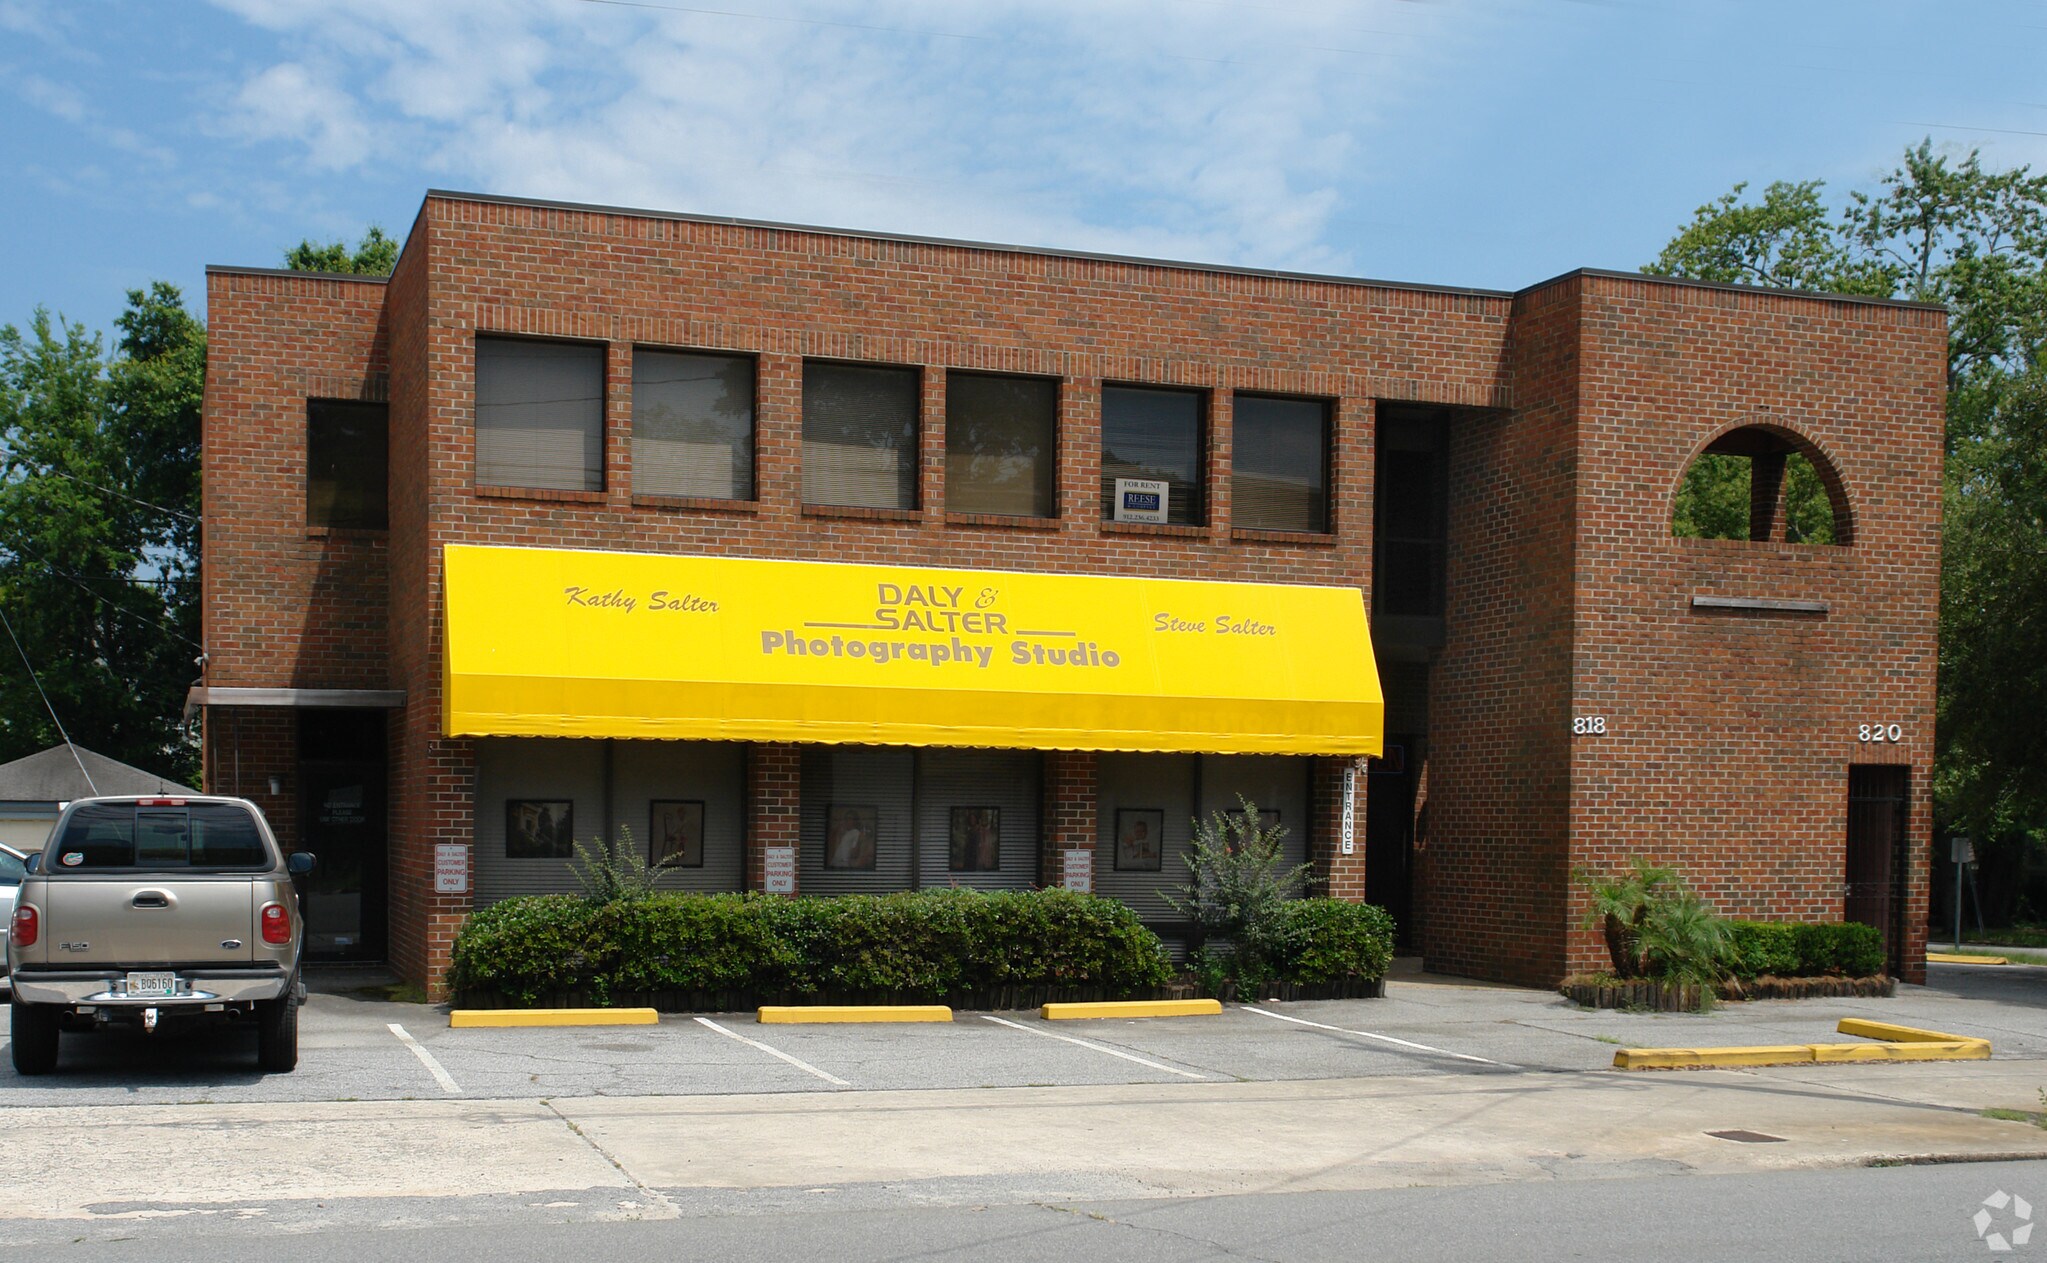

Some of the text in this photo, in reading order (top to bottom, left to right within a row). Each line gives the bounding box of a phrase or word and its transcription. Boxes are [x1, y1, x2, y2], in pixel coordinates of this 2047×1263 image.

[1128, 494, 1156, 504] REESE
[564, 586, 719, 613] Kathy Salter
[878, 583, 999, 609] DALY &
[875, 609, 1007, 634] SALTER
[1154, 612, 1276, 636] Steve Salter
[761, 630, 1120, 668] Photography Studio
[1573, 716, 1606, 734] 818
[1858, 724, 1901, 741] 820
[1345, 772, 1353, 850] ENTRANCE
